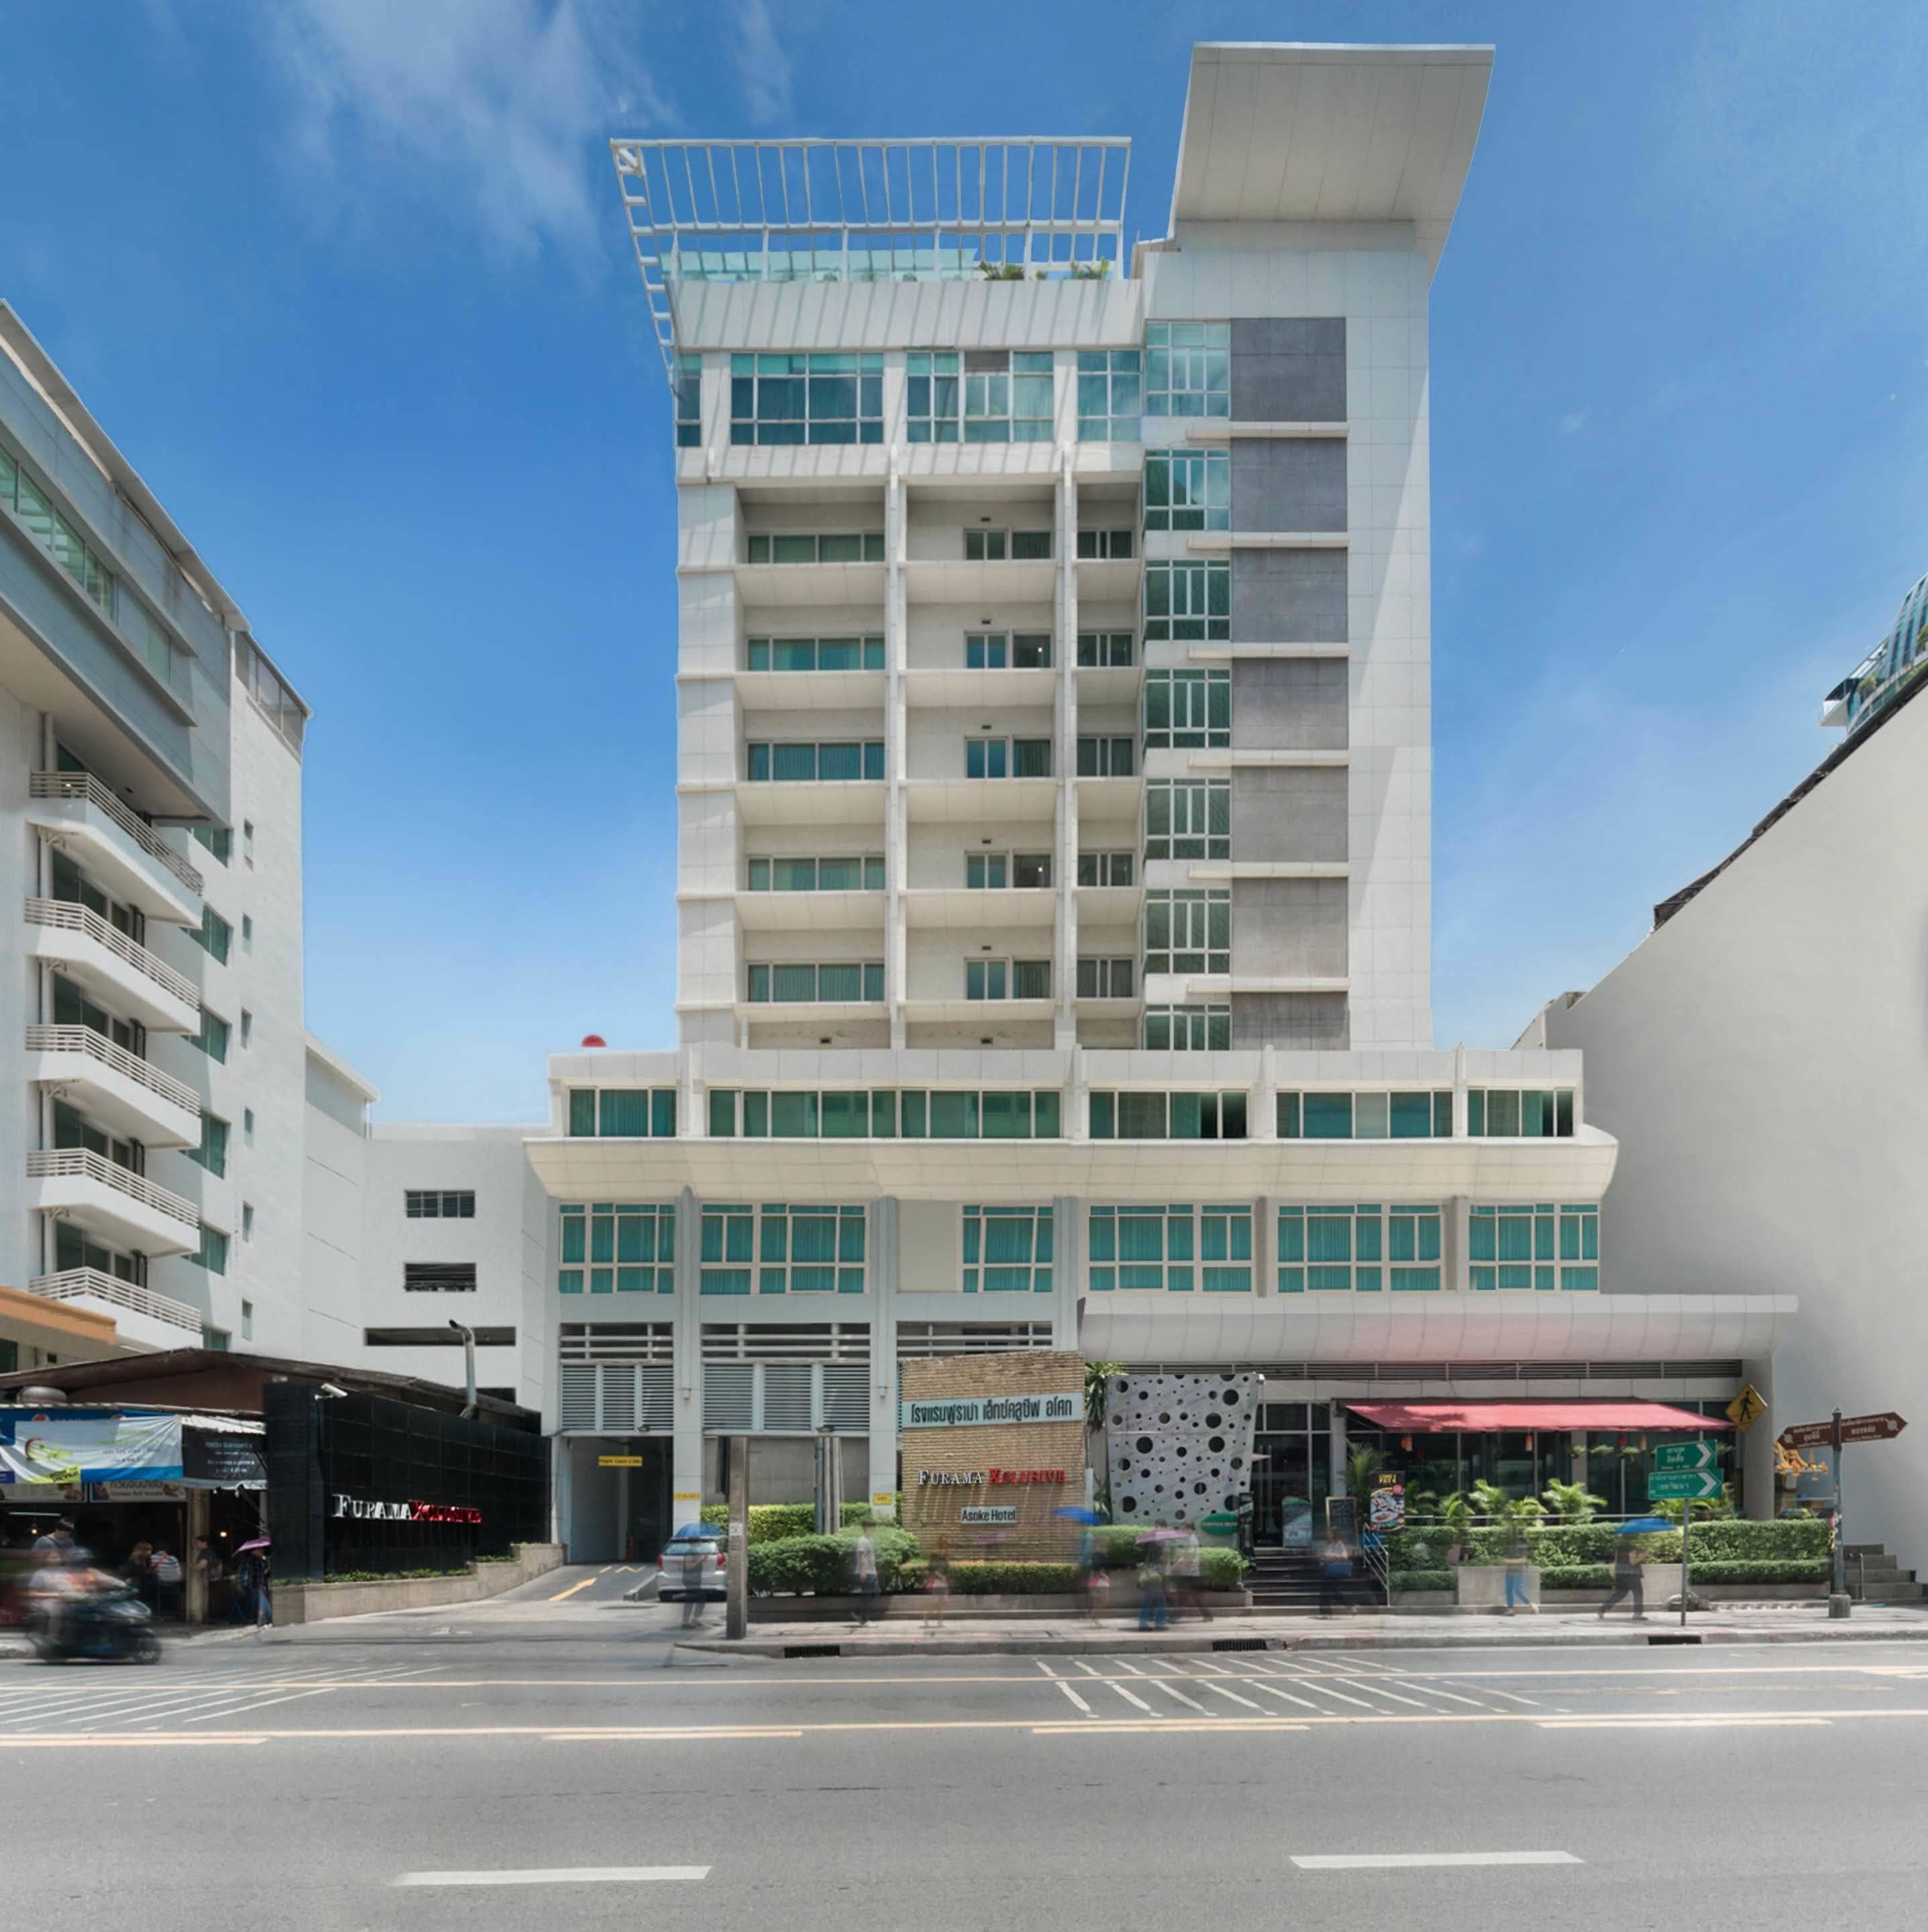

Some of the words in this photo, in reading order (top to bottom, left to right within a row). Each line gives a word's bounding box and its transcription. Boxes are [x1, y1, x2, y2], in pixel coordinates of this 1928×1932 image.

[1046, 1395, 1072, 1417] อโศก
[918, 1469, 983, 1485] FURAMA
[987, 1467, 1067, 1485] XCLUSIVE
[332, 1493, 412, 1520] FURAMA
[961, 1509, 990, 1521] Asoke
[991, 1509, 1016, 1521] Hotel
